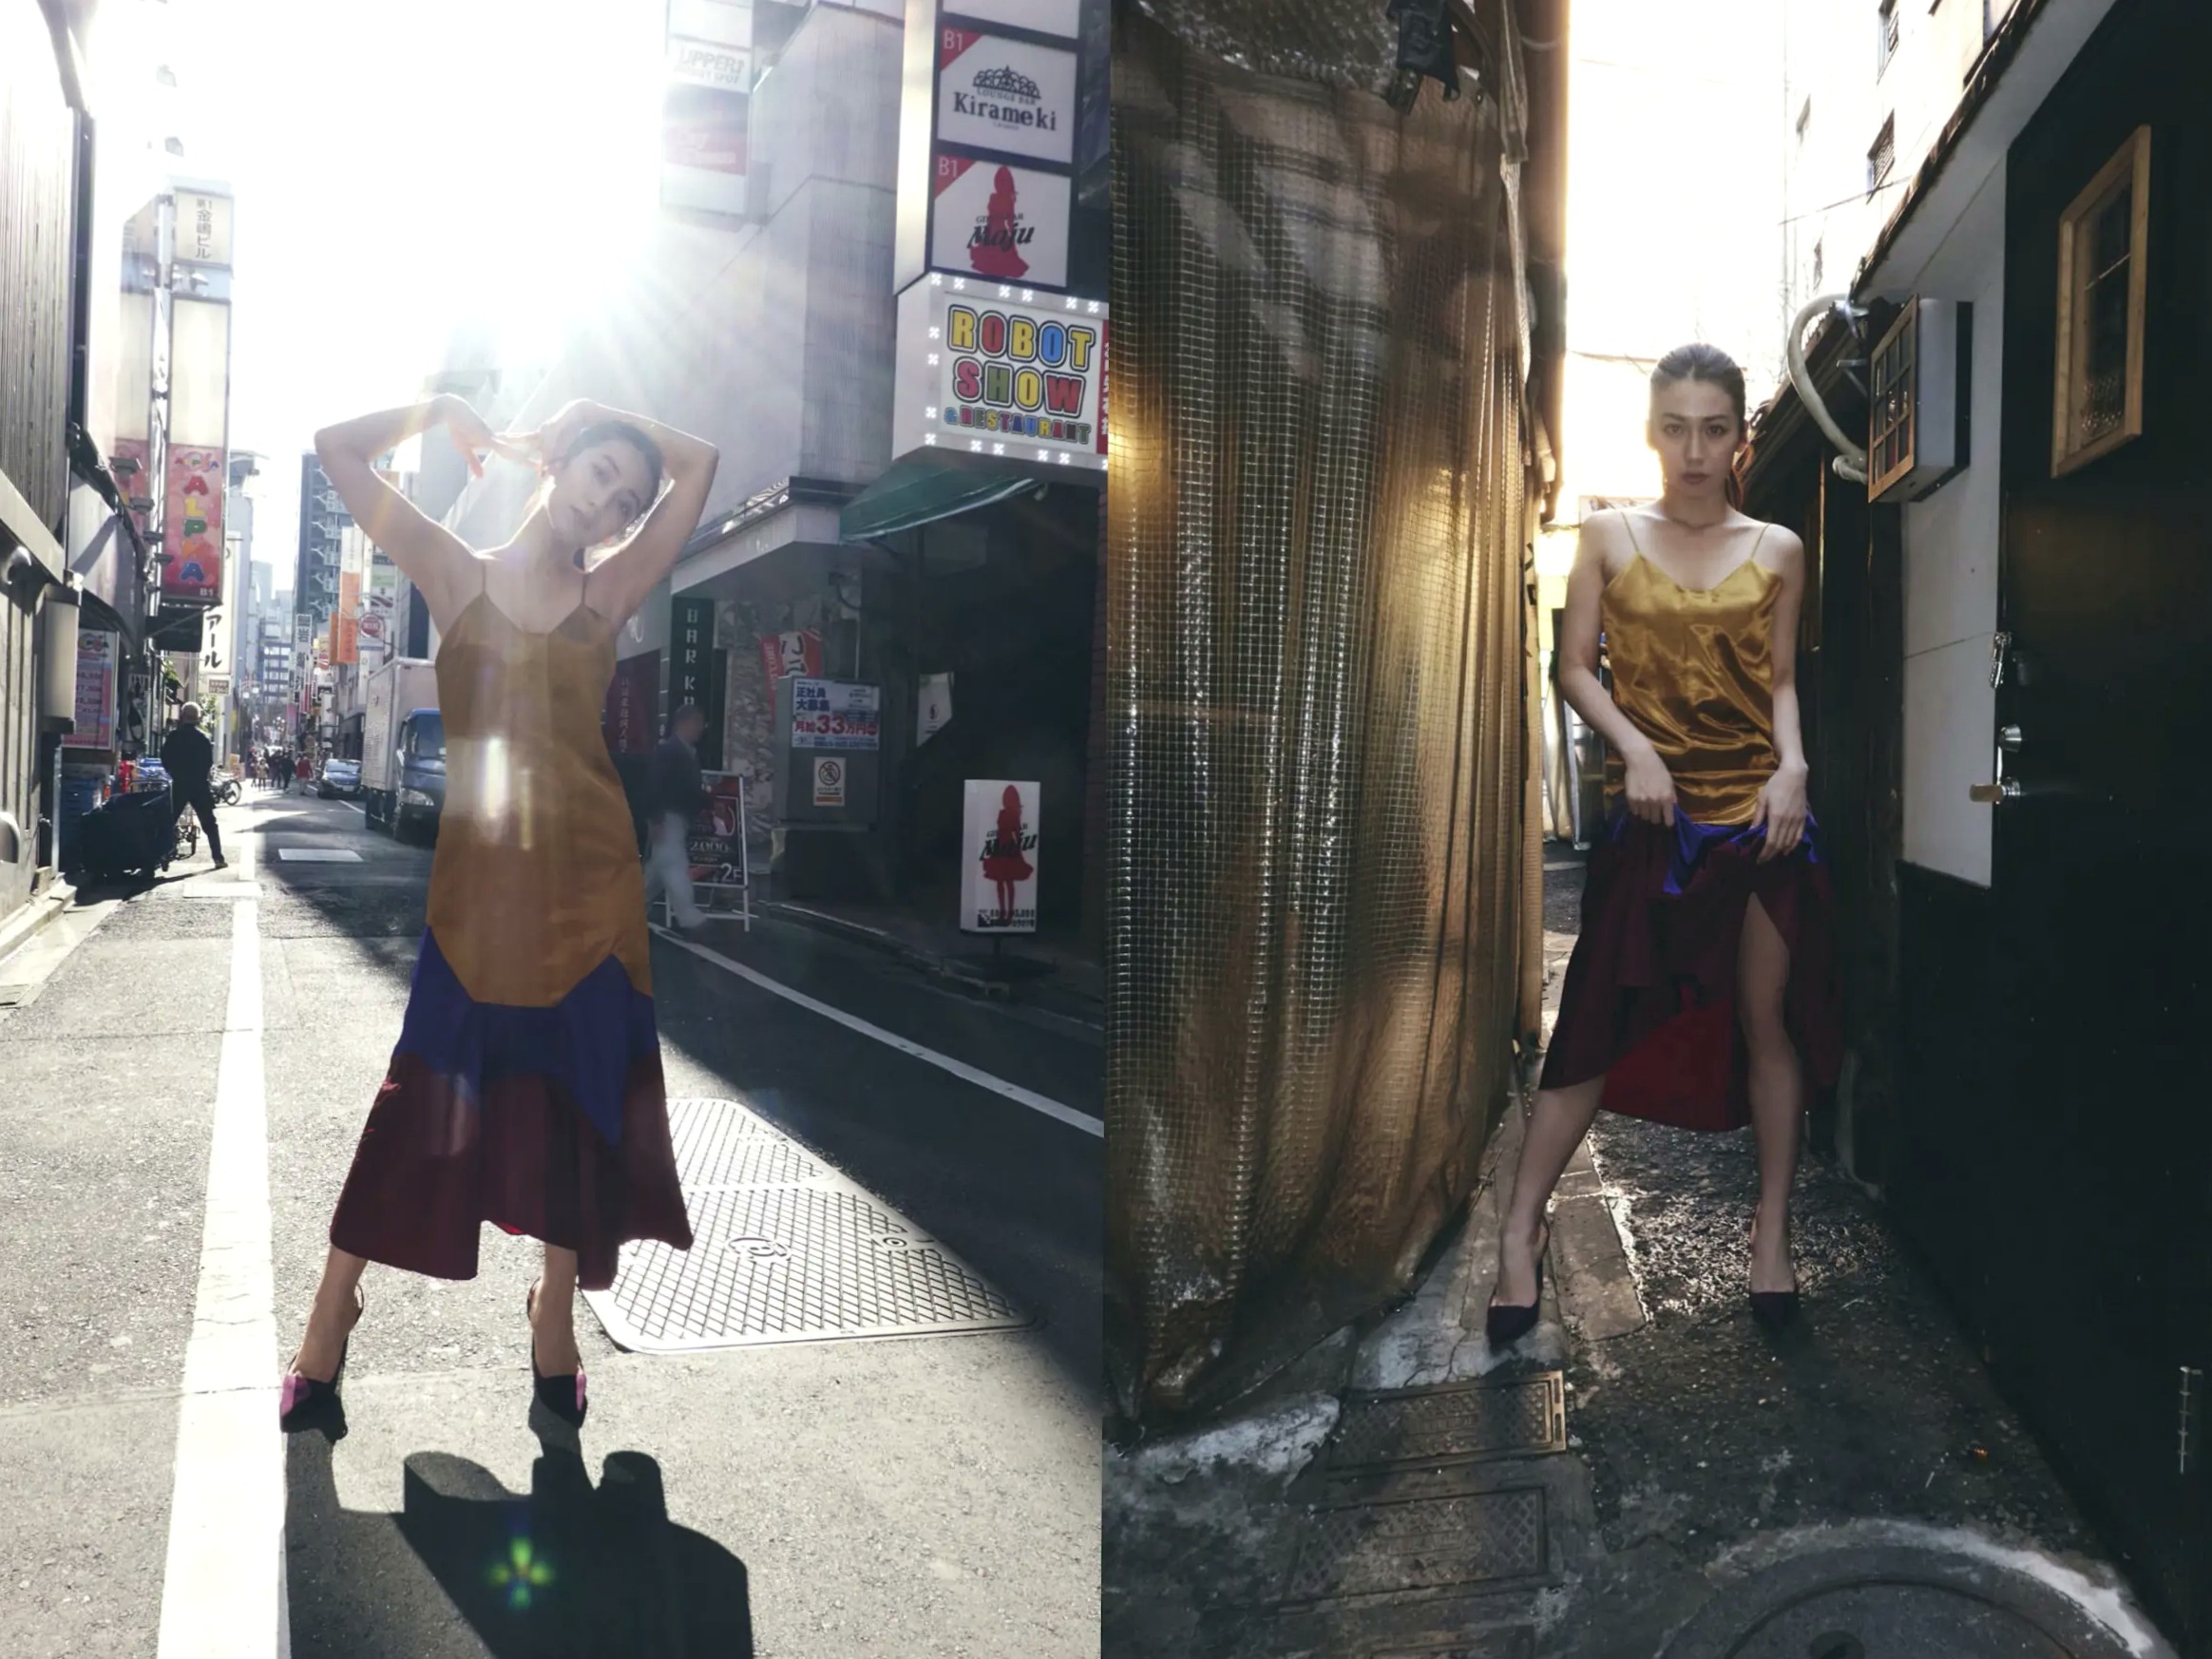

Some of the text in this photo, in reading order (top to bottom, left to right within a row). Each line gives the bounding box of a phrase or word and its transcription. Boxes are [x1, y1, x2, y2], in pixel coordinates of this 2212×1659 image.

[944, 29, 963, 52] B1
[977, 86, 1015, 102] LOUNGE
[953, 91, 1057, 131] Kirameki
[938, 157, 958, 177] B1
[966, 222, 1035, 252] Maju
[948, 304, 1096, 372] ROBOT
[953, 356, 1086, 418] SHOW
[960, 405, 1091, 445] RESTAURANT
[200, 587, 214, 598] B1
[721, 863, 742, 883] 2F
